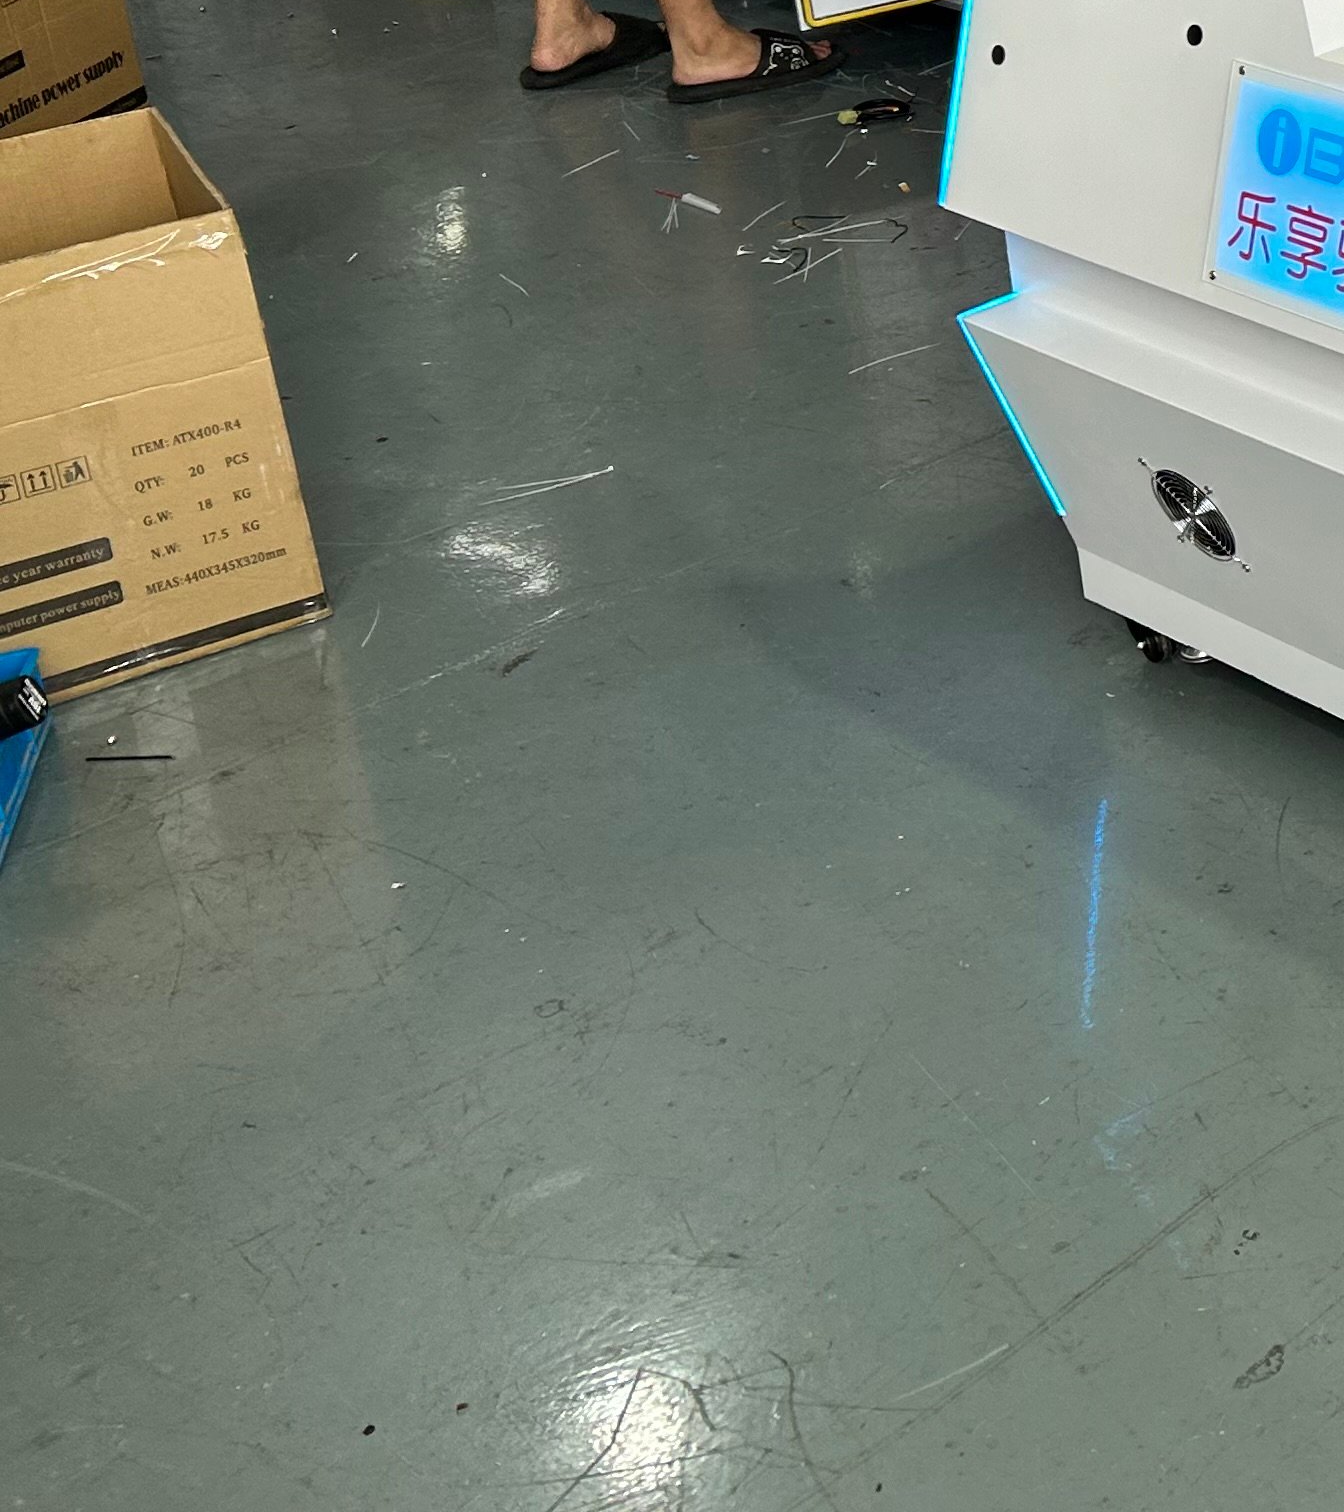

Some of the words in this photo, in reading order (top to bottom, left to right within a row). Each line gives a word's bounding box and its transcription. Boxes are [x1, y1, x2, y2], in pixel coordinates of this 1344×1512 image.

[42, 72, 82, 106] power
[82, 49, 125, 84] supply
[131, 438, 169, 457] ITEM:
[172, 419, 242, 446] ATX400-R4
[188, 464, 205, 478] 20
[224, 451, 250, 468] PCS
[197, 498, 214, 512] 18
[232, 487, 252, 502] KG
[202, 528, 230, 545] 17.5
[241, 519, 260, 534] KG
[13, 564, 42, 584] year
[44, 547, 105, 572] warranty
[39, 601, 78, 623] power
[79, 588, 121, 611] supply
